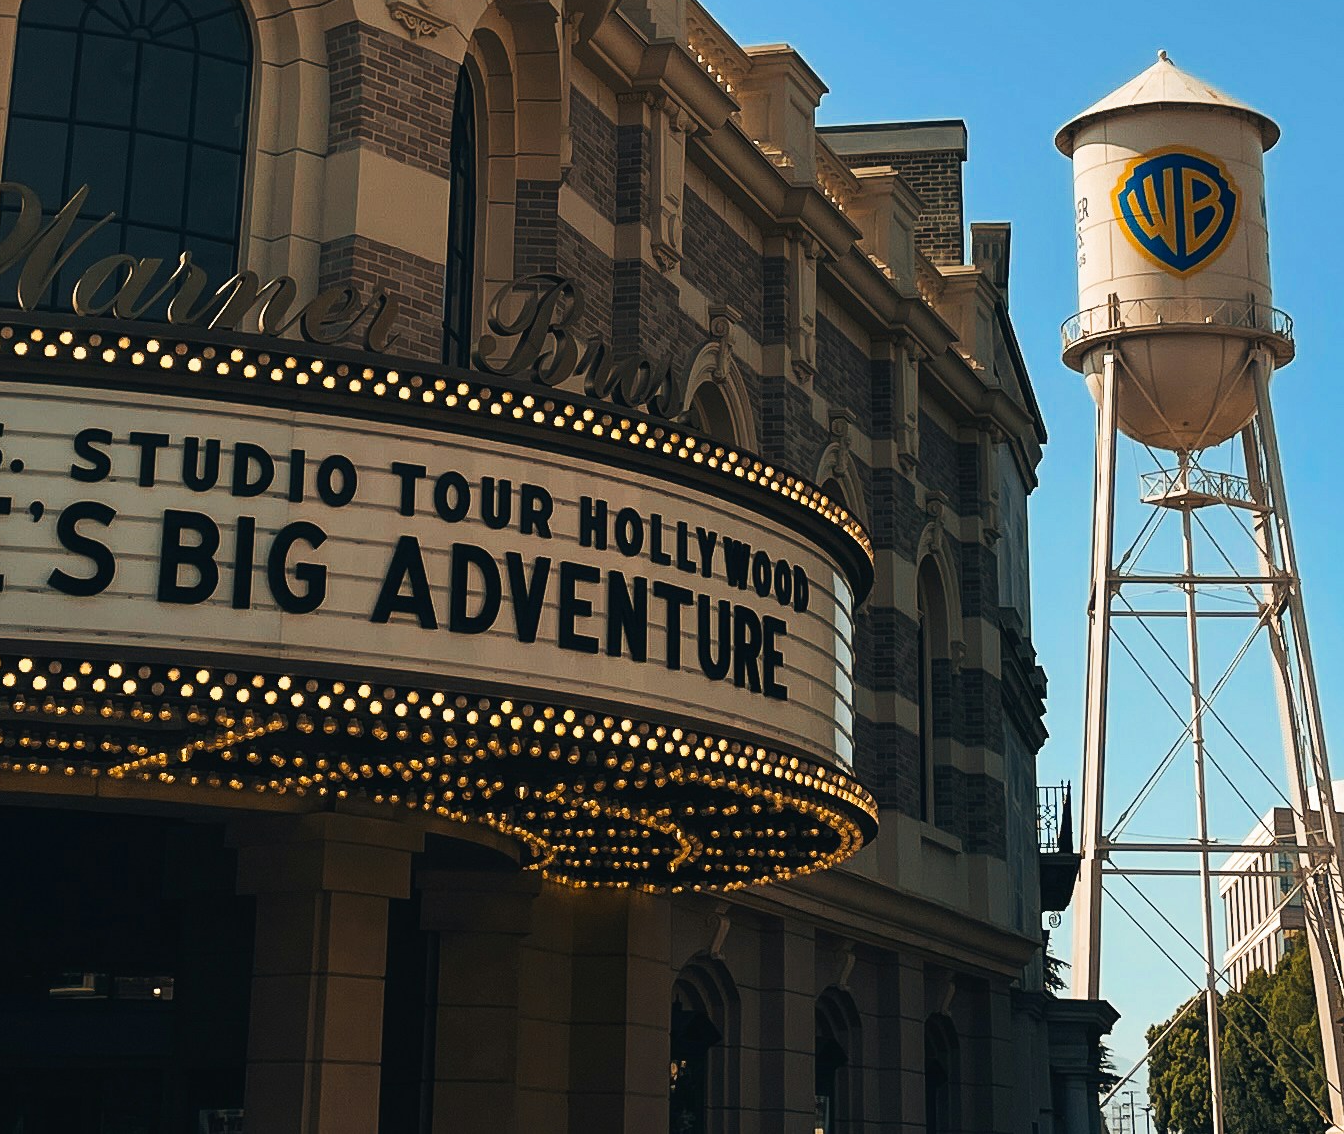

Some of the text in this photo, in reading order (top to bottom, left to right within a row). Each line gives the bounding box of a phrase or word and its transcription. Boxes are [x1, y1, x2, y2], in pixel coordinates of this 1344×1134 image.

[1127, 166, 1225, 257] WB
[70, 428, 359, 507] STUDIO
[391, 461, 554, 539] TOUR
[579, 496, 810, 614] HOLLYWOOD
[157, 508, 328, 615] BIG
[370, 535, 789, 701] ADVENTURE
